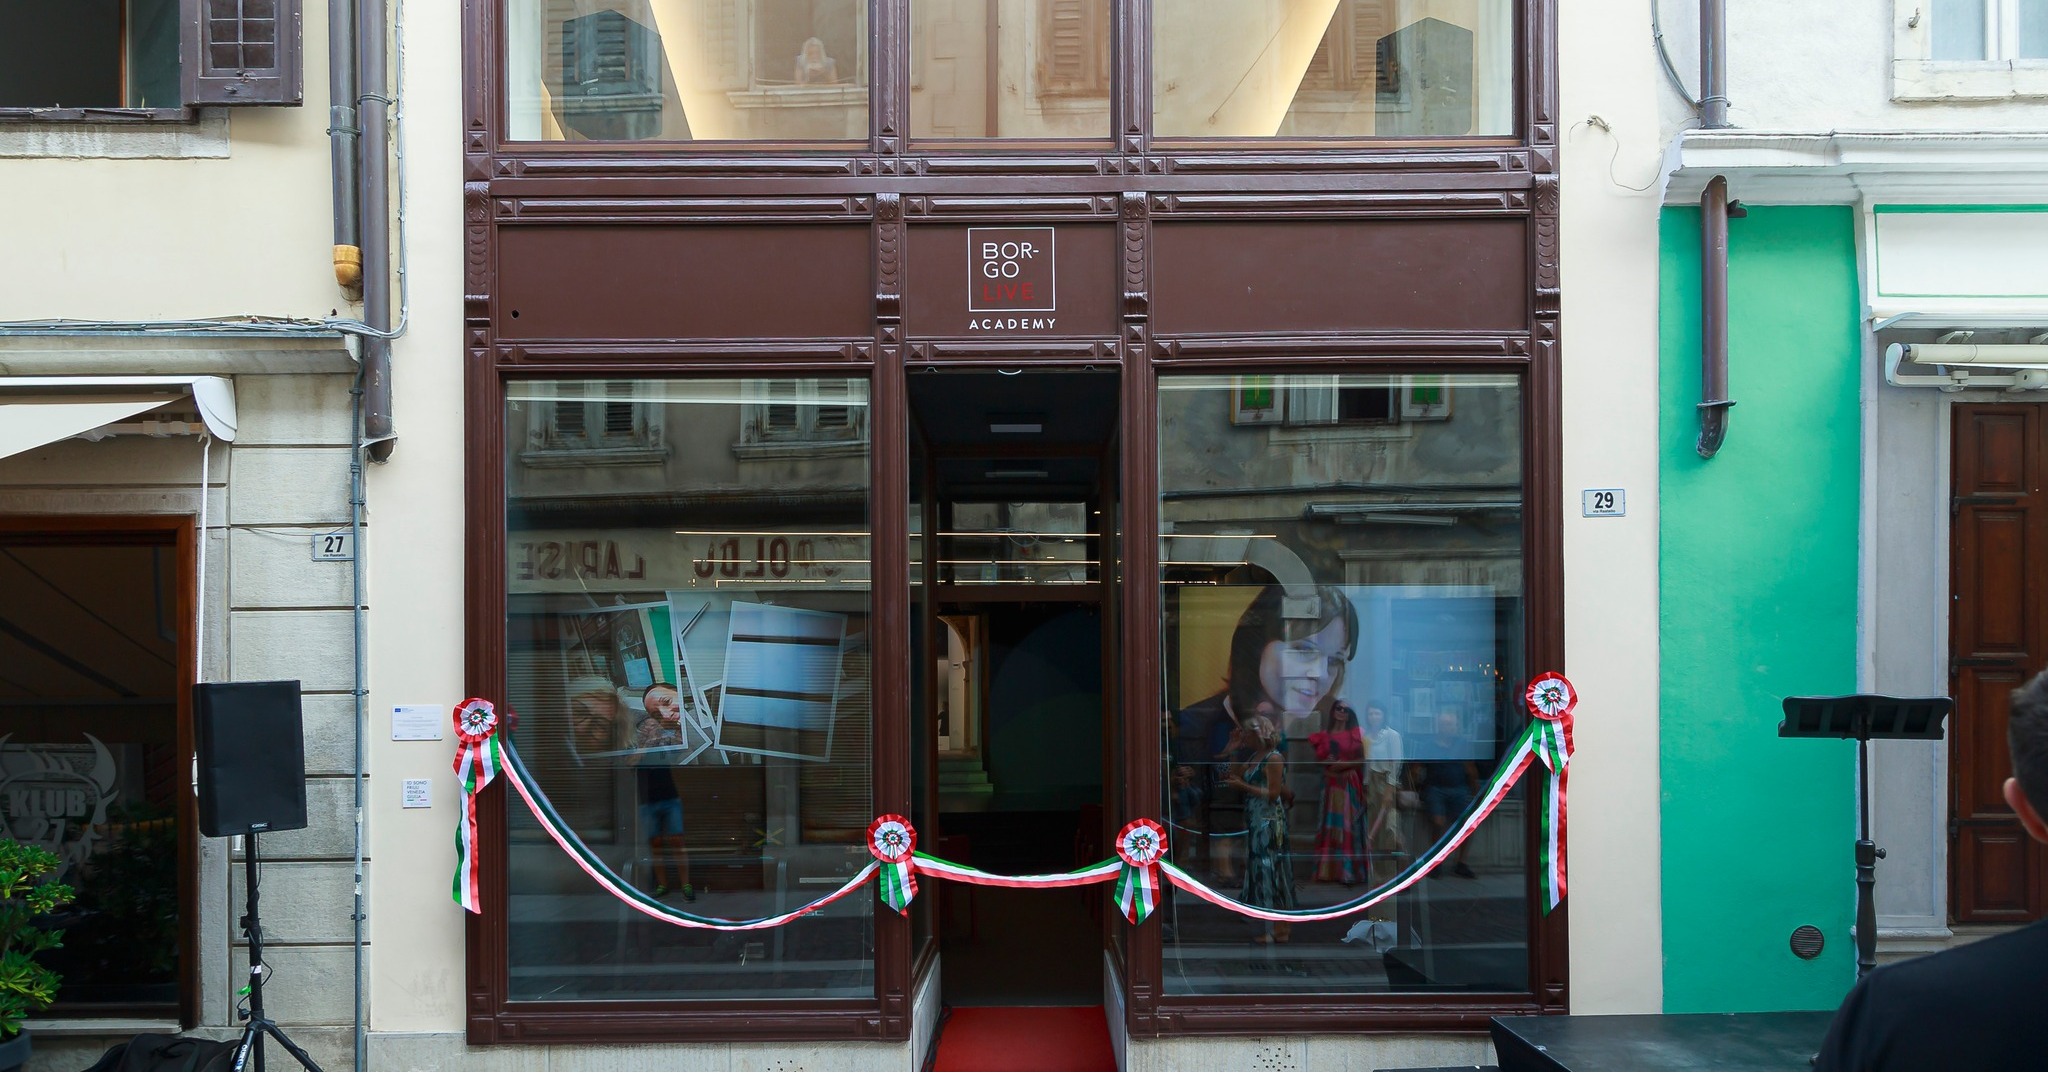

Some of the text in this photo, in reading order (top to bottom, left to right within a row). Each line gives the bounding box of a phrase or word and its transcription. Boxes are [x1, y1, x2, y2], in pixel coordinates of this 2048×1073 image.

[983, 242, 1039, 259] BOR-
[983, 261, 1019, 278] GO
[983, 282, 1034, 301] LIVE
[969, 319, 1056, 330] ACADEMY
[1594, 492, 1614, 509] 29
[324, 536, 344, 553] 27
[10, 789, 87, 817] KLUB
[31, 818, 66, 848] 27
